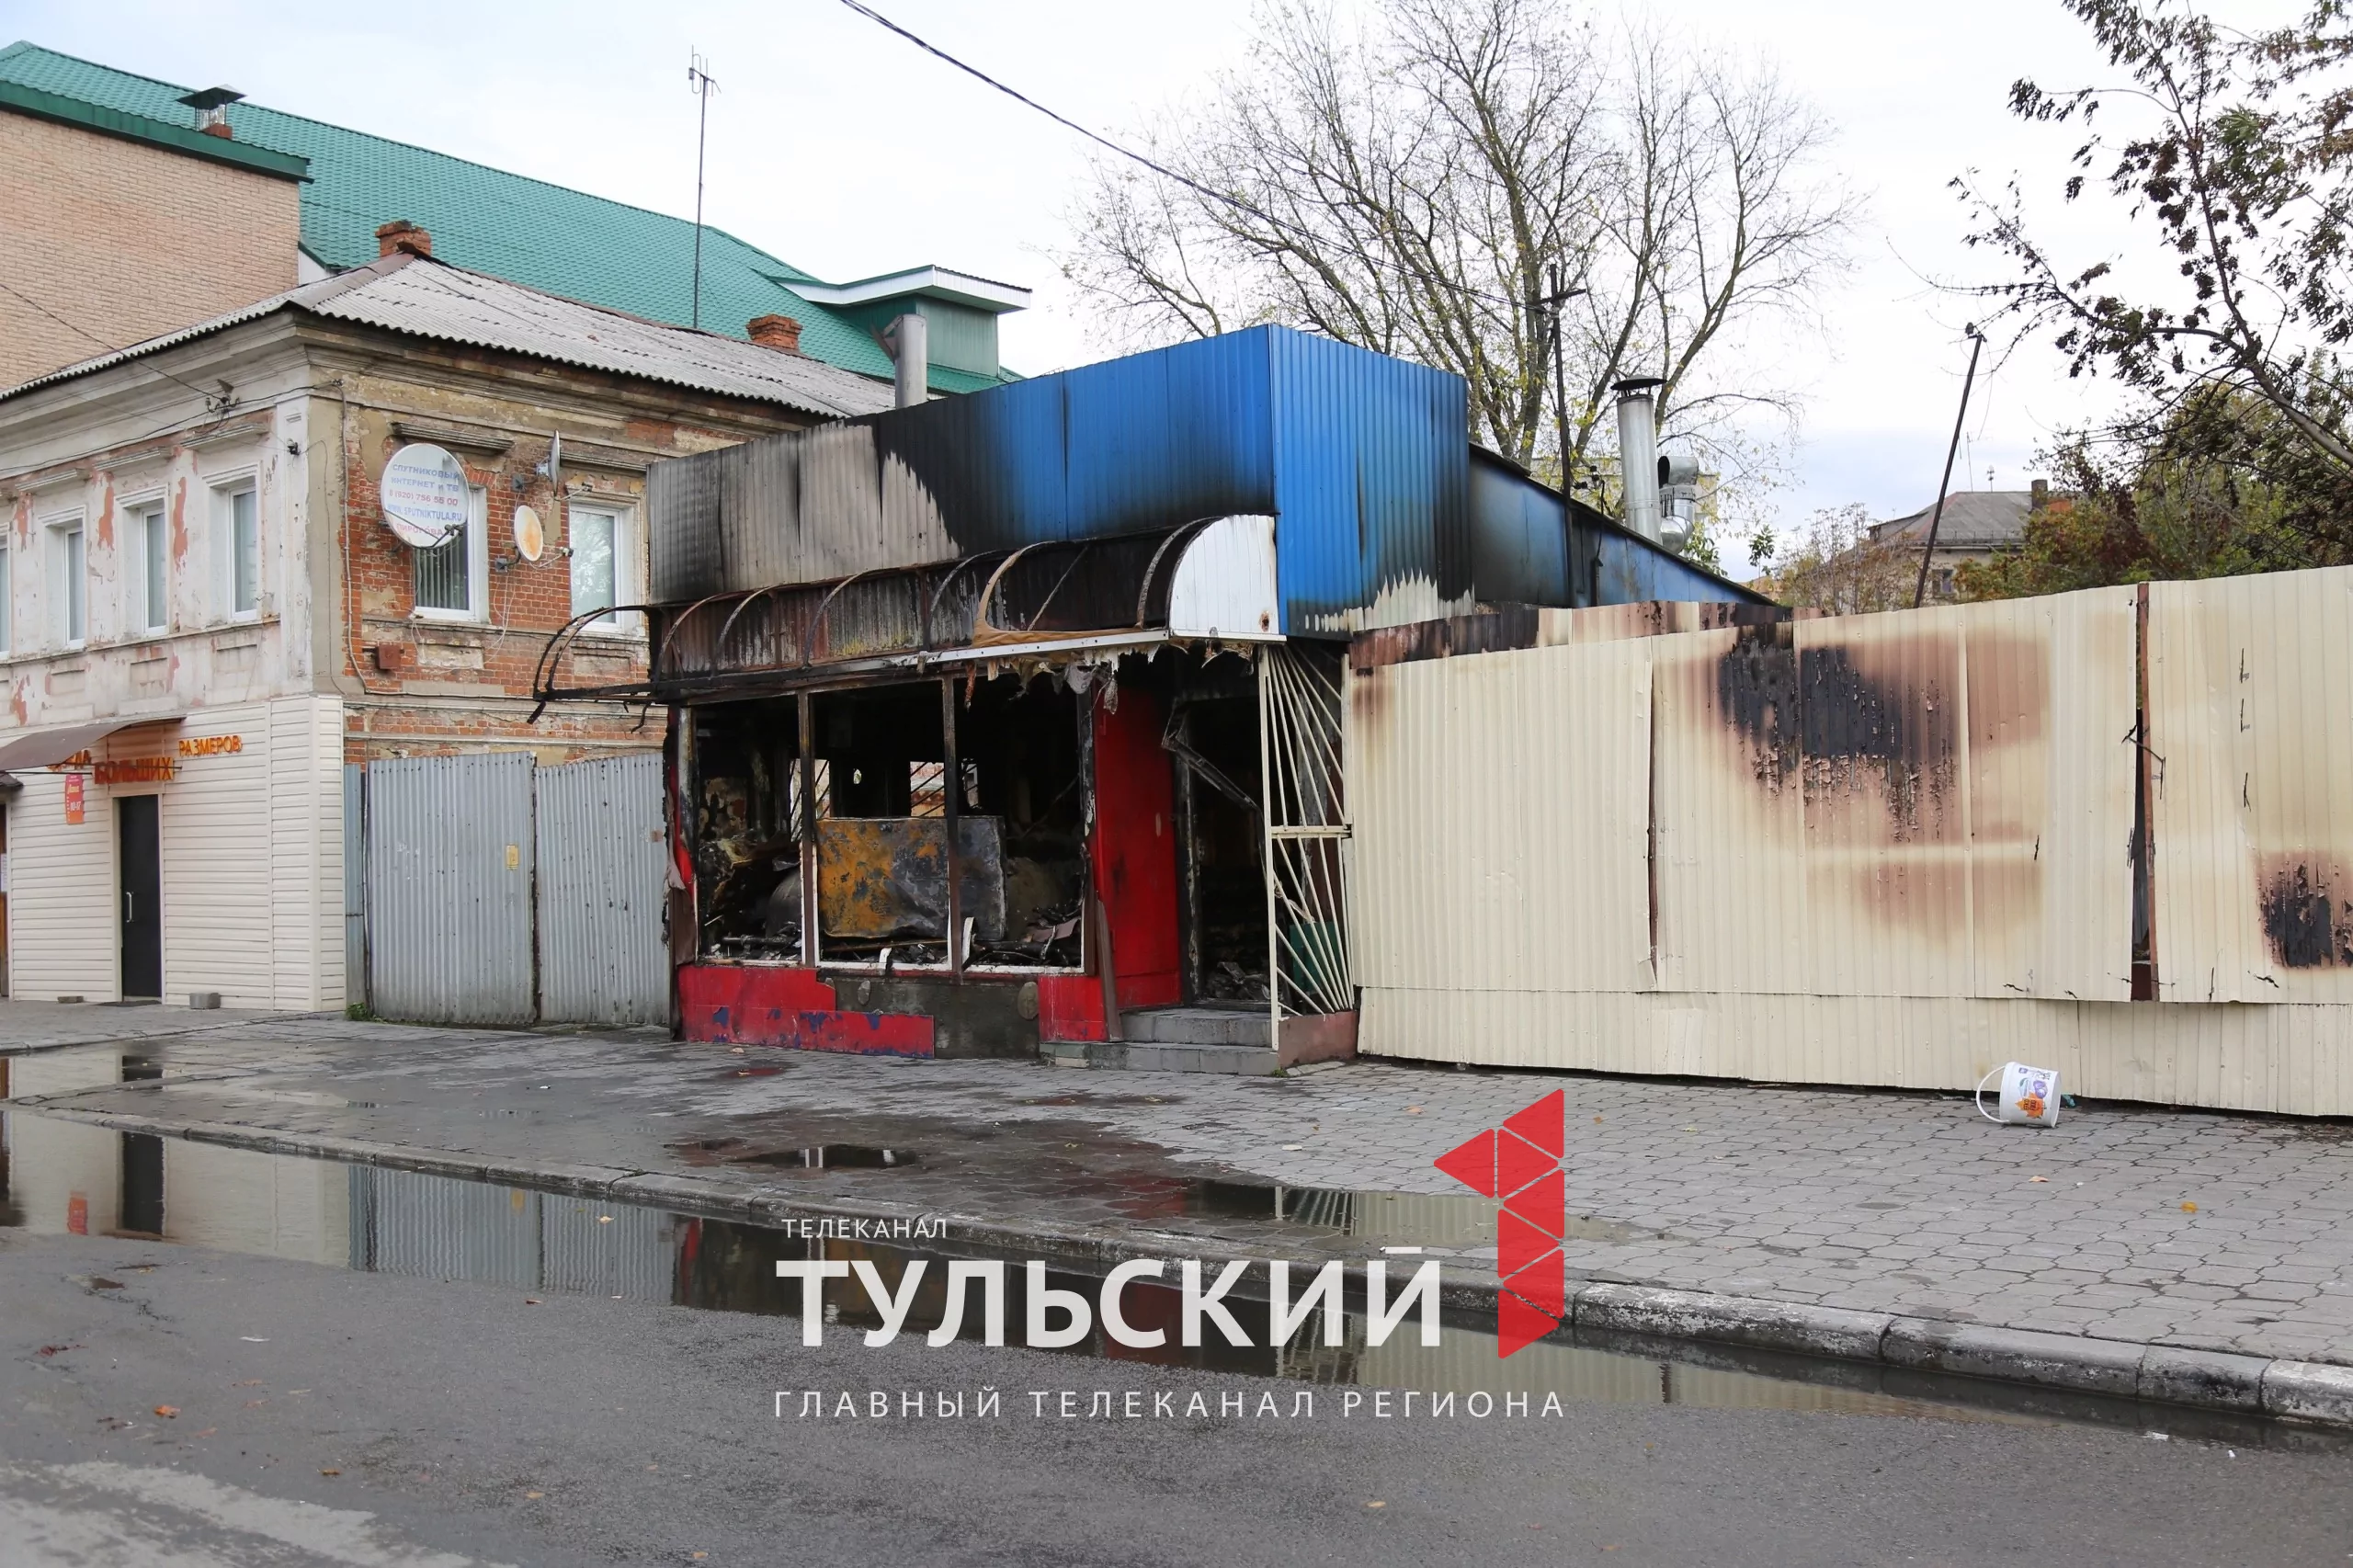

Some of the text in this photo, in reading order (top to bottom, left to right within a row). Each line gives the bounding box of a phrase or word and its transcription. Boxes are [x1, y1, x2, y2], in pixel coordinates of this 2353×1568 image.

[392, 464, 460, 480] СПУТНИКОВЫЙ
[391, 477, 435, 488] ИНТЕРНЕТ
[447, 483, 459, 492] ТВ
[415, 494, 431, 502] 756
[434, 495, 444, 504] 55
[447, 497, 458, 506] 00
[94, 757, 173, 784] БОЛЬШИХ
[179, 735, 243, 756] РАЗМЕРОВ
